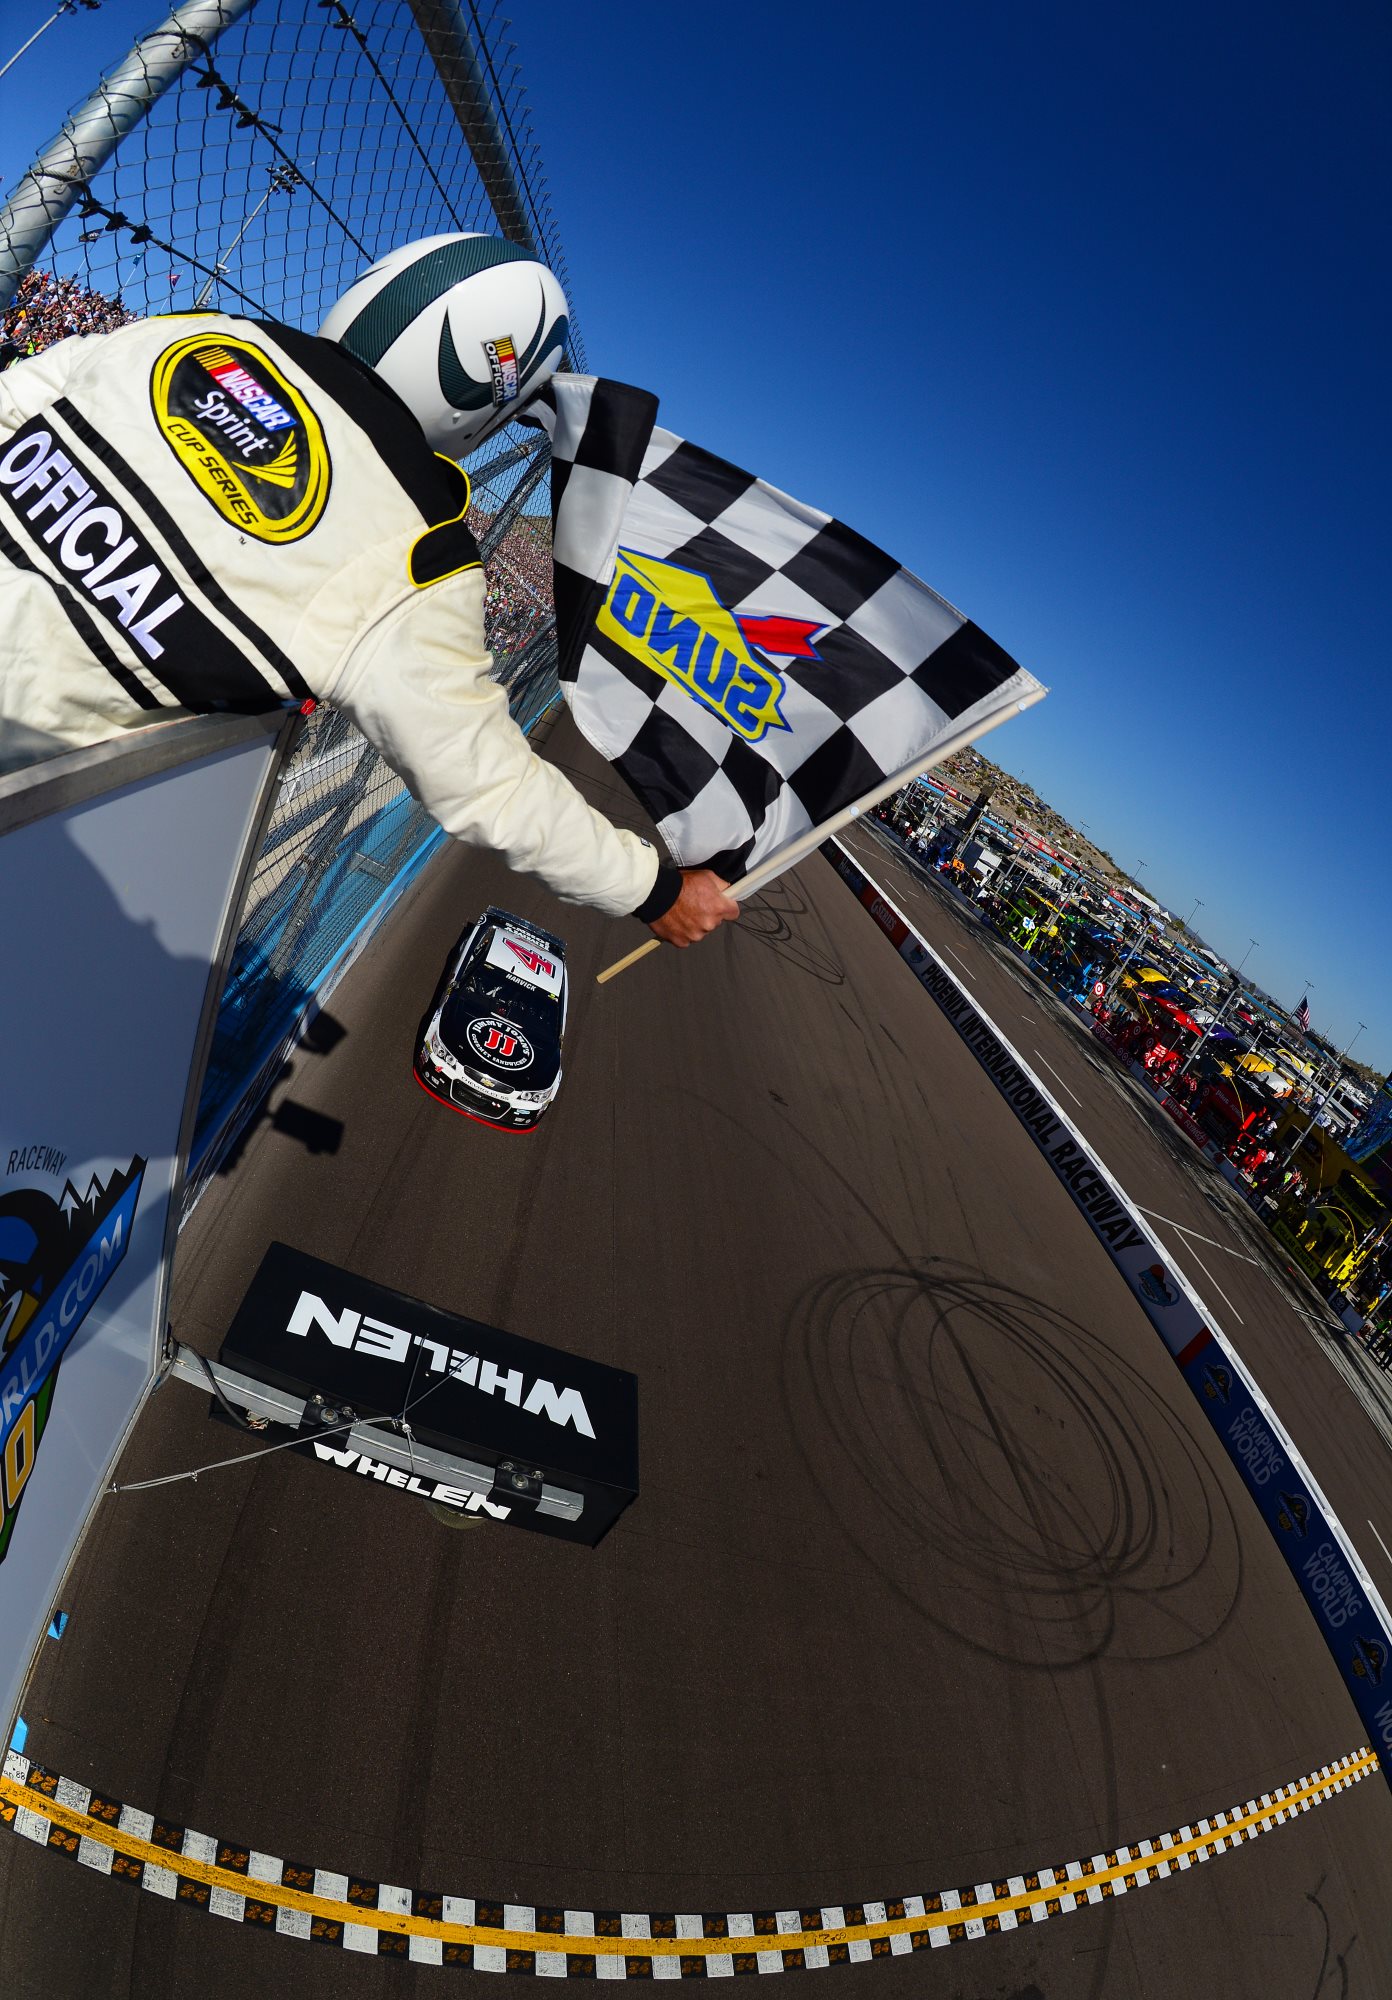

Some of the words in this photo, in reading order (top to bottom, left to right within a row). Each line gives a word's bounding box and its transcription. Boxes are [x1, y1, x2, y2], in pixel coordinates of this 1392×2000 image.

[214, 367, 291, 432] NASCAR
[486, 342, 504, 402] OFFICIAL
[501, 358, 518, 400] NASCAR
[194, 390, 270, 458] Sprint
[167, 423, 206, 452] CUP
[198, 456, 260, 525] SERIES
[0, 430, 184, 660] OFFICIAL
[502, 937, 557, 979] 4
[505, 973, 537, 992] HARVICK
[471, 1020, 503, 1033] JIMMY
[484, 1027, 518, 1057] JJ
[921, 963, 971, 1020] PHOENIX
[958, 1013, 1061, 1146] INTERNATIONAL
[1049, 1139, 1146, 1253] RACEWAY
[6, 1145, 68, 1177] RACEWAY
[0, 1213, 123, 1434] RLD.COM
[286, 1290, 597, 1439] WHELEN
[1227, 1416, 1271, 1486] WORLD
[1240, 1407, 1285, 1474] CAMPING
[313, 1442, 512, 1520] WHELEN
[1302, 1551, 1348, 1629] WORLD
[1317, 1542, 1363, 1617] CAMPING
